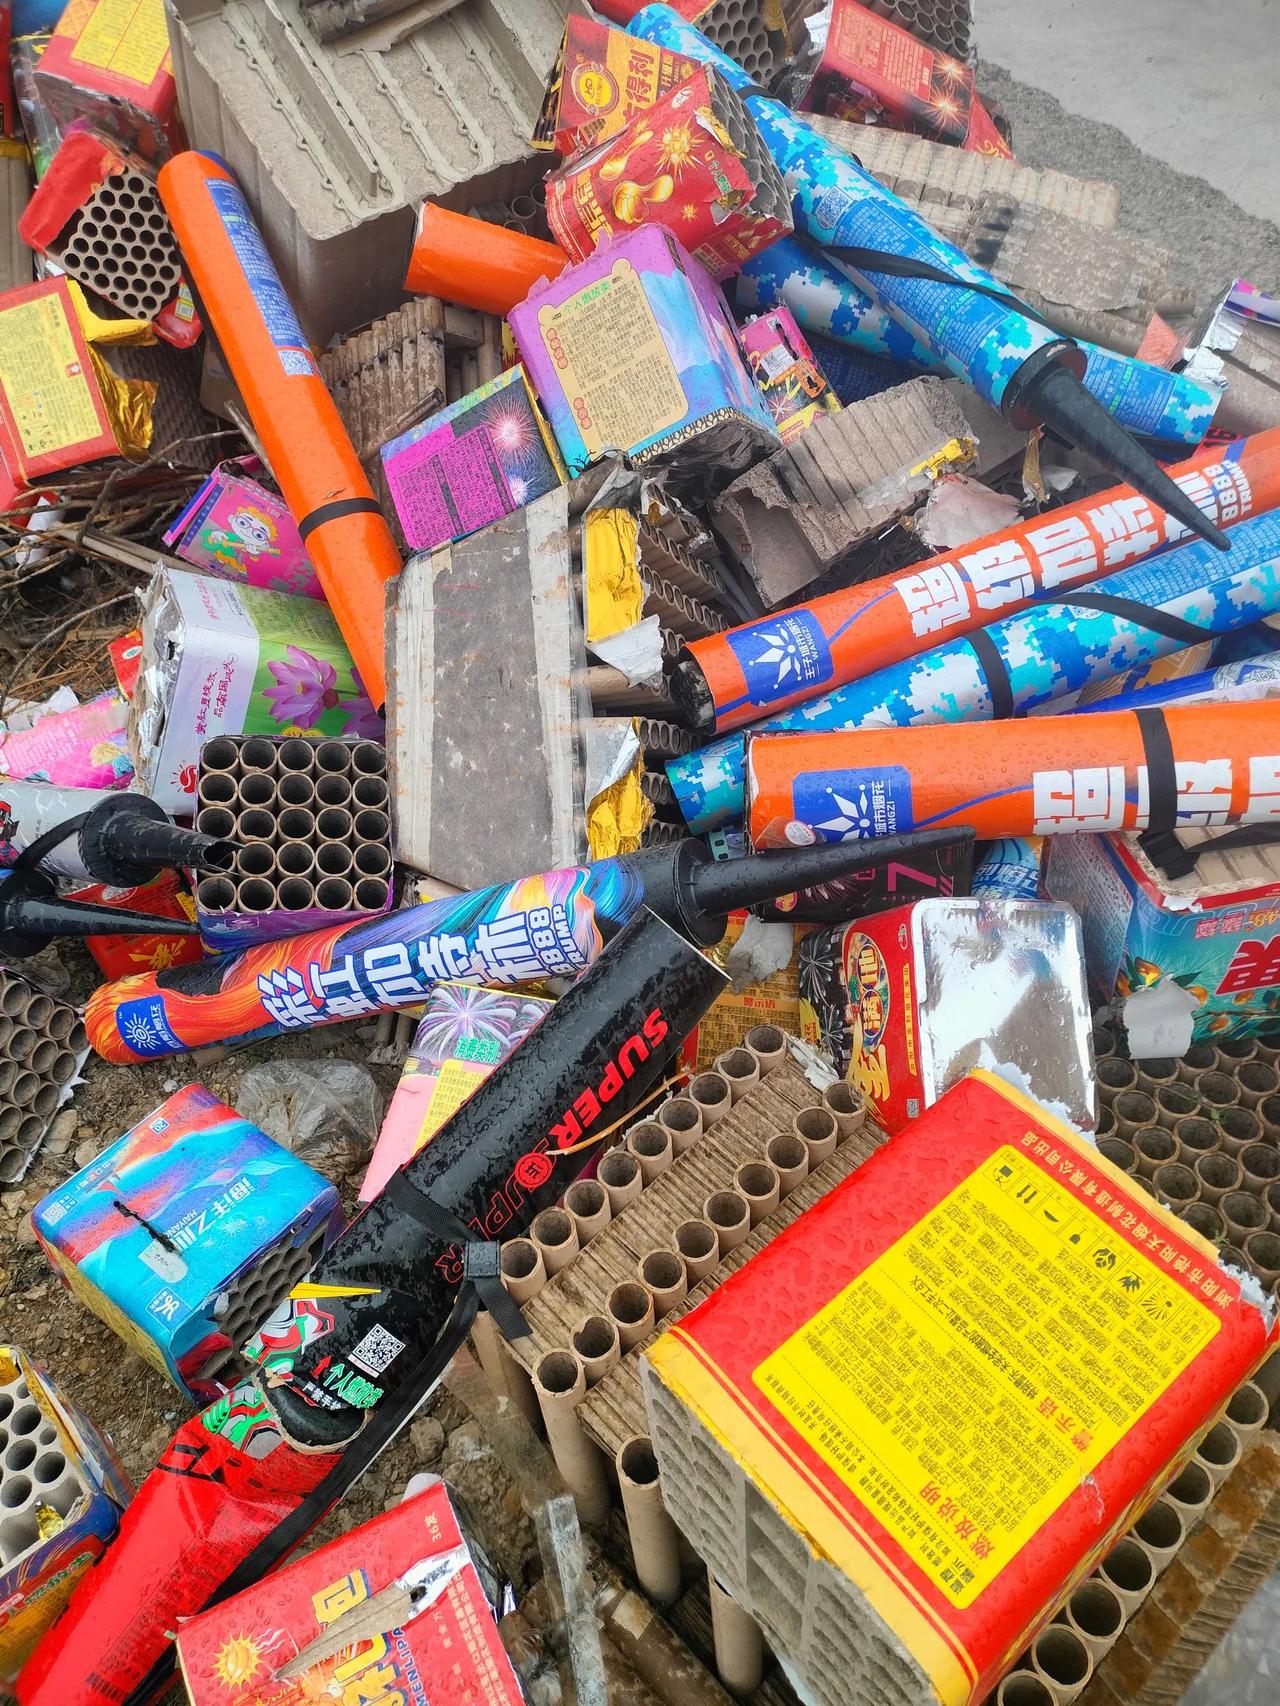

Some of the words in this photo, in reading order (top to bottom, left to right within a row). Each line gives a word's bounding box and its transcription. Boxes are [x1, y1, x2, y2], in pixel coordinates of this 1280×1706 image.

[1207, 462, 1242, 519] 8888
[1220, 456, 1258, 512] TRUMP
[788, 615, 820, 681] 王子城市烟花
[803, 624, 820, 661] WANGZI
[526, 906, 575, 975] 8888
[258, 911, 530, 1033] 彩虹加特林
[743, 996, 776, 1009] 警示语
[548, 1008, 671, 1149] SUPER
[1017, 1127, 1238, 1309] 浏阳市艳阳天烟花制造有限公司出品
[323, 1364, 383, 1407] 个人燃放类
[1034, 1394, 1094, 1453] 警示语
[422, 1511, 443, 1542] 36发
[917, 1478, 997, 1562] 燃放说明
